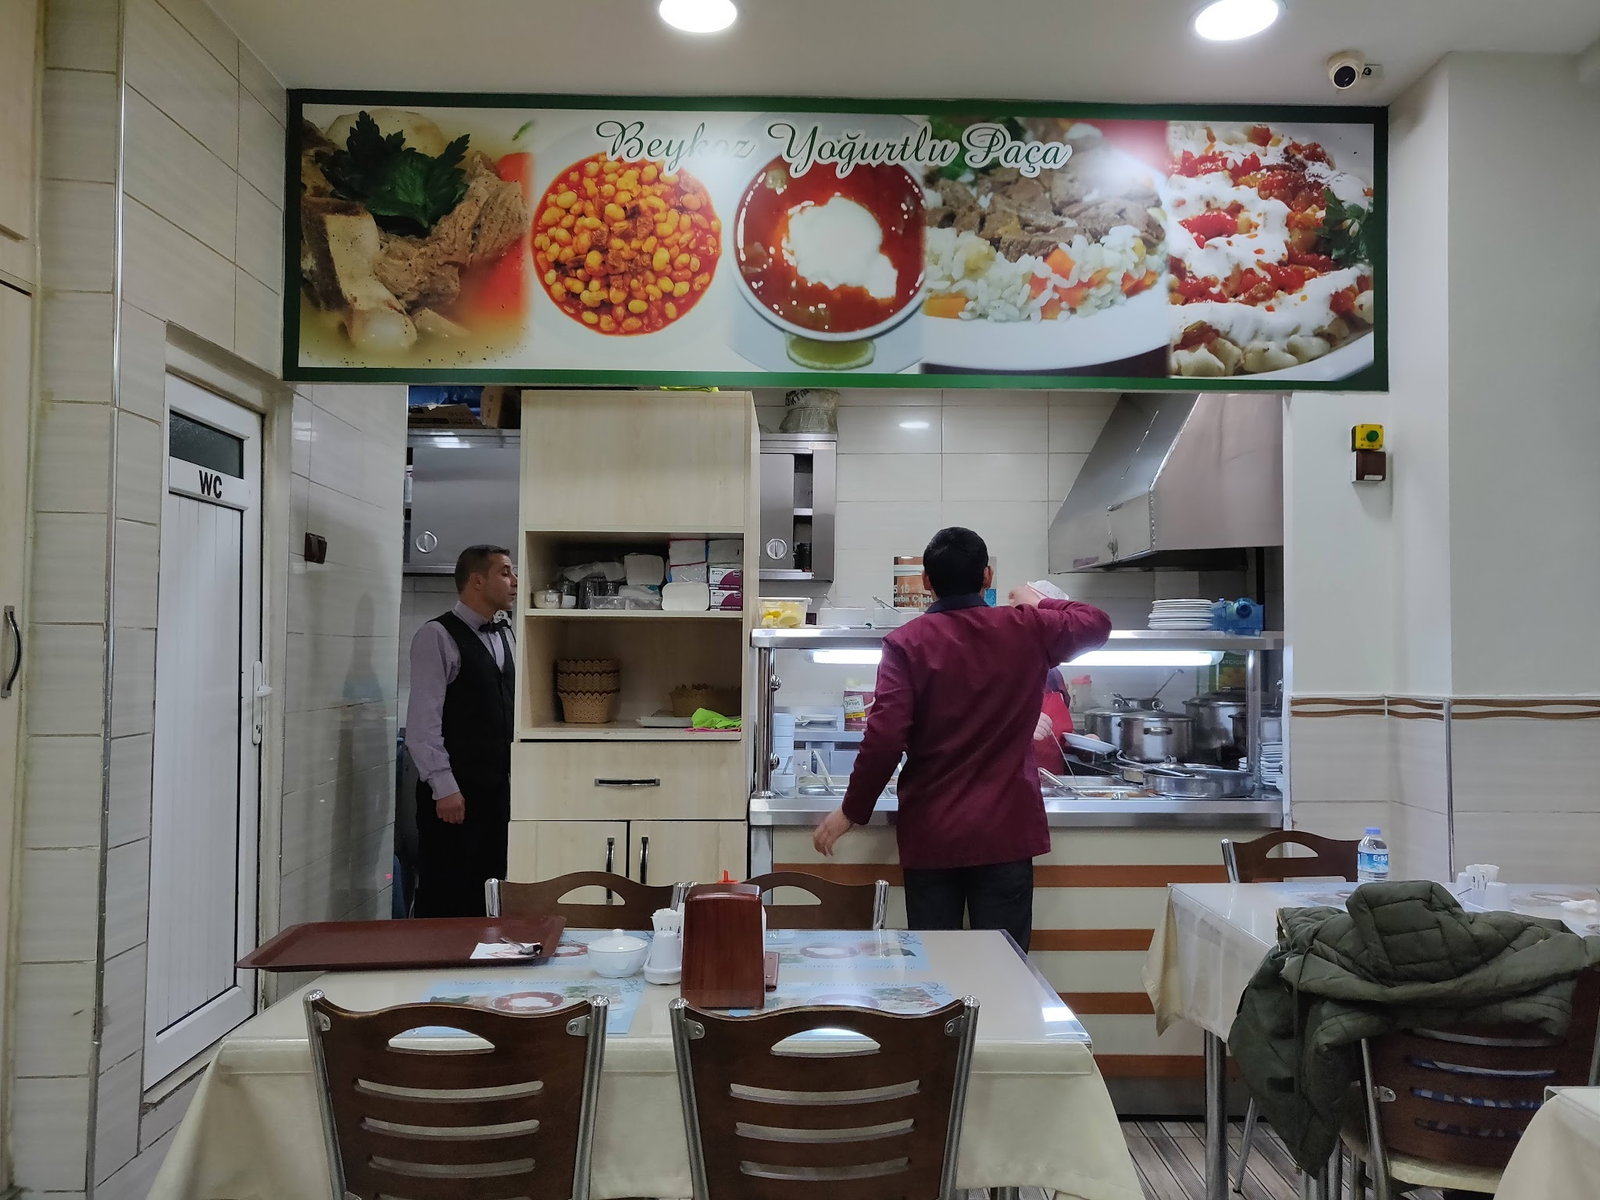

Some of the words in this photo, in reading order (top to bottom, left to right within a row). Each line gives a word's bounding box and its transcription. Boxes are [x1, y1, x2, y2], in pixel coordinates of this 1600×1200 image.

[596, 120, 756, 172] Beykoz
[767, 123, 956, 174] Yoğurtlu
[966, 126, 1069, 174] Paça
[198, 469, 222, 499] WC
